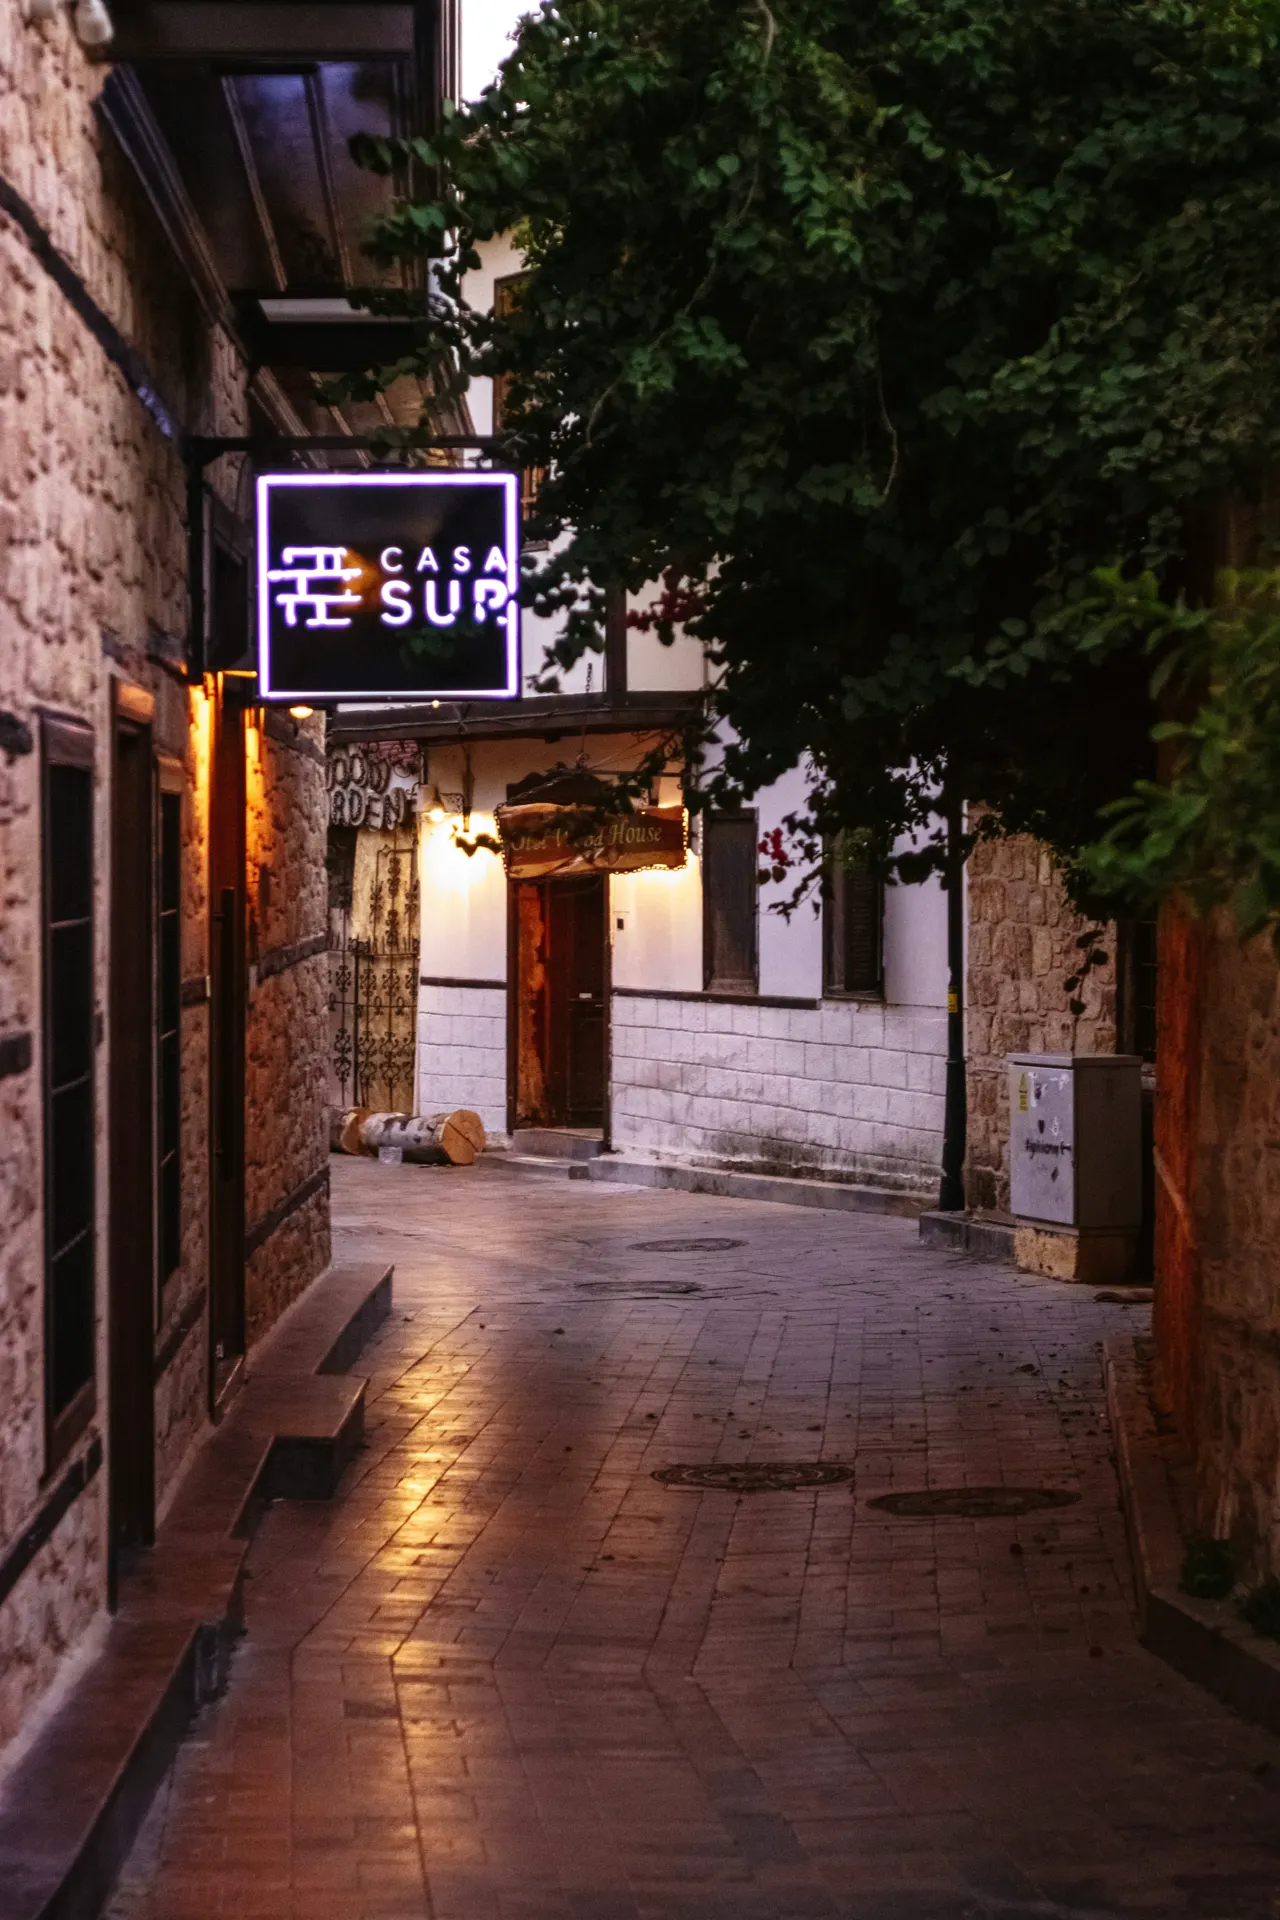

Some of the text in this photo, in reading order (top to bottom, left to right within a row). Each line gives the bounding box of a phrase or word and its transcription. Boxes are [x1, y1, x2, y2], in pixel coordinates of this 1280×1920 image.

[380, 546, 507, 572] CASA
[380, 578, 508, 625] SUR
[325, 754, 391, 794] OOD
[331, 786, 406, 831] RDEN
[608, 819, 663, 846] House
